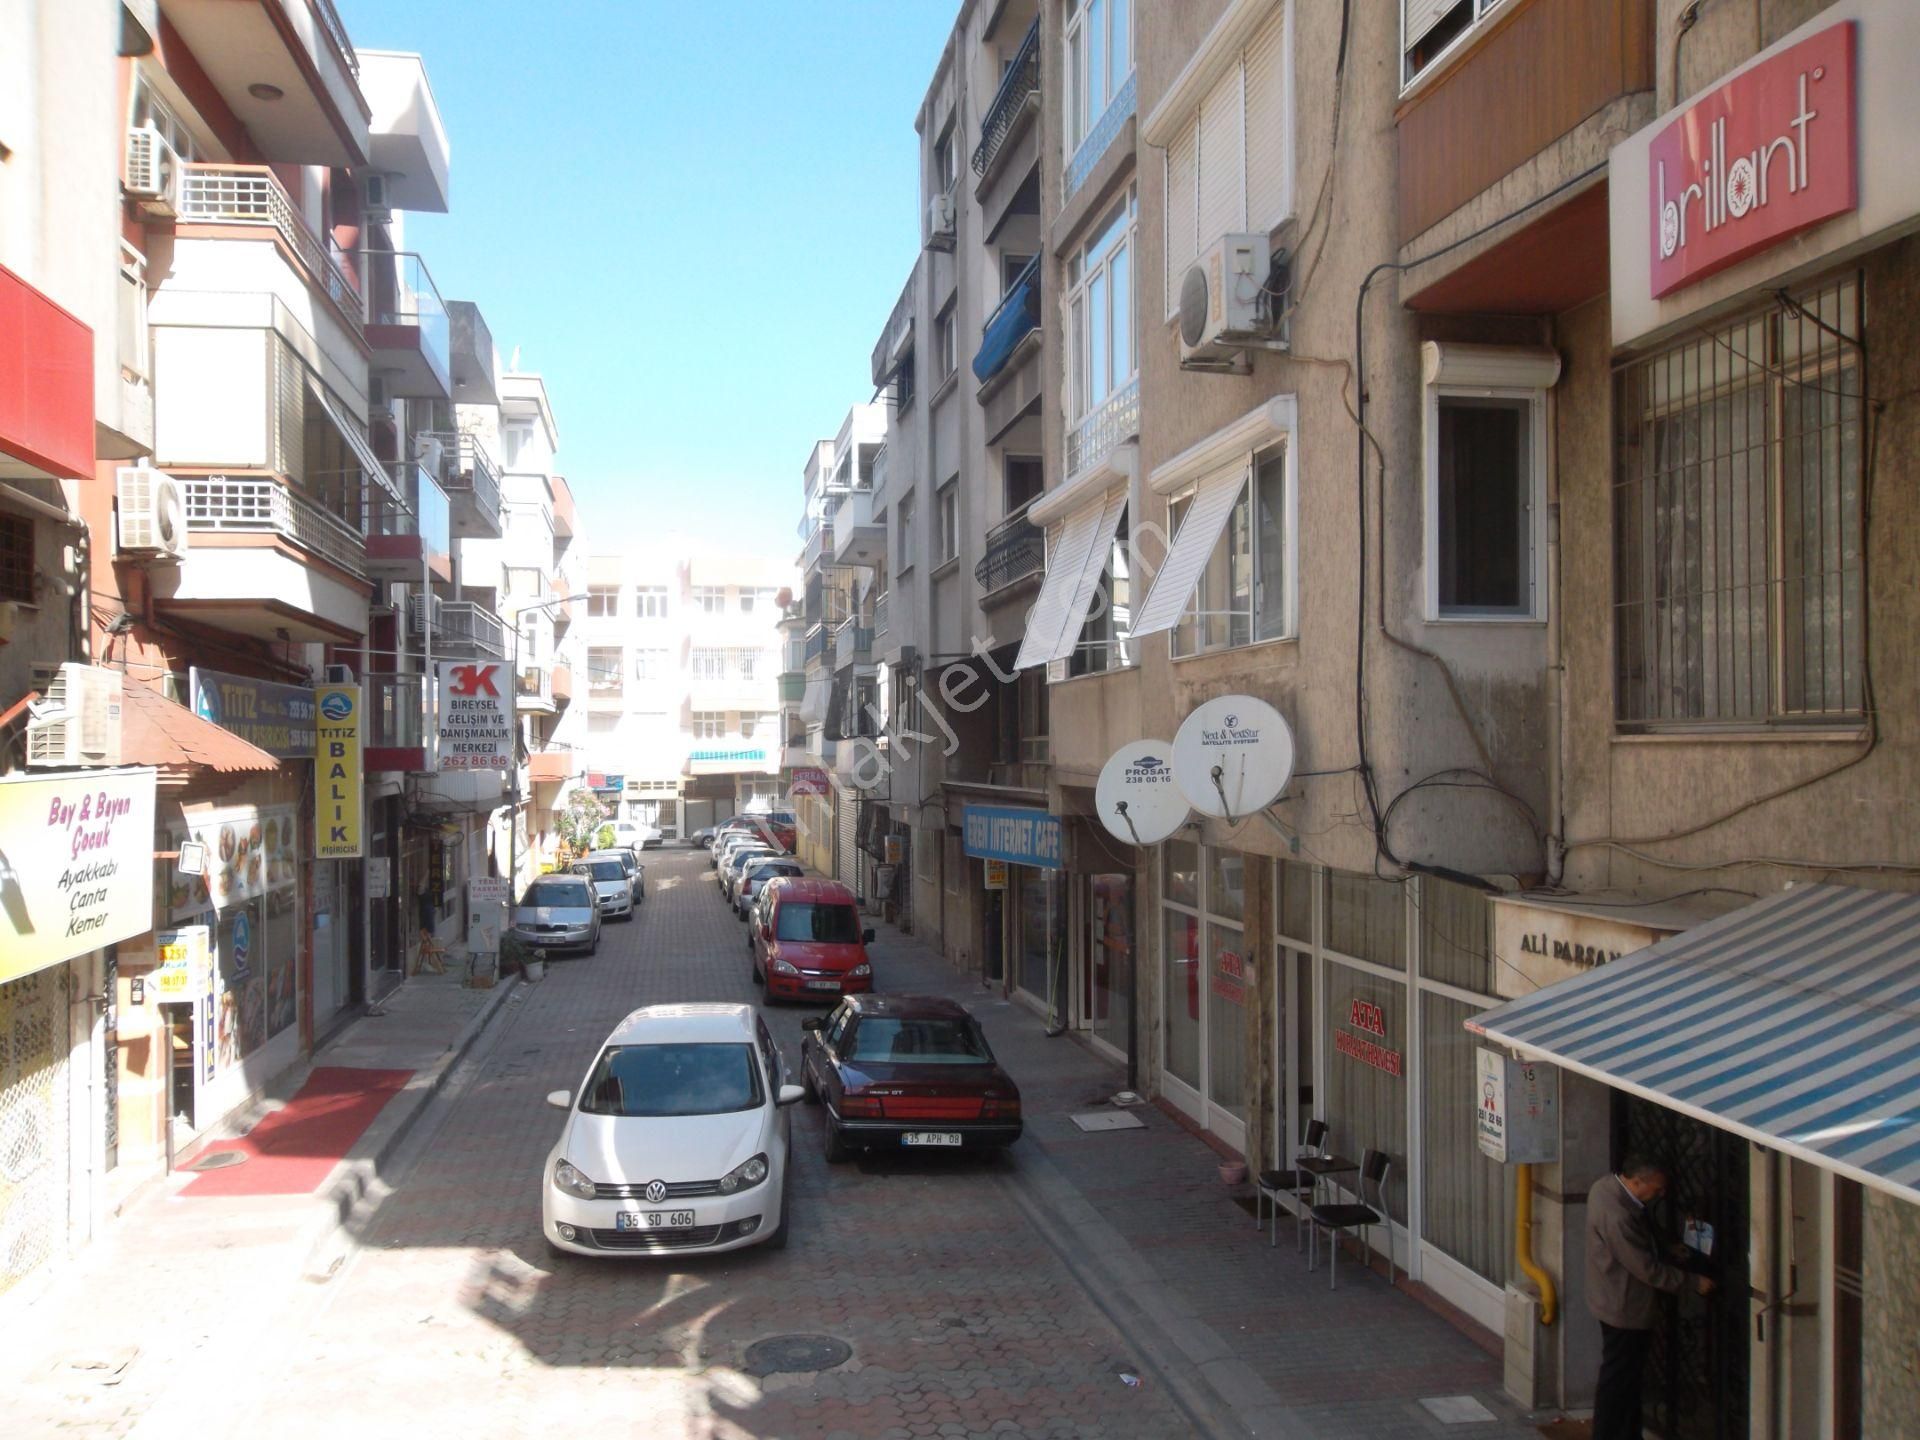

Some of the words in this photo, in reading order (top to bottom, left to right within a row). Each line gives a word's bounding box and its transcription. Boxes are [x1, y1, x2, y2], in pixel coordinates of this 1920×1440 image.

[1659, 71, 1818, 260] brillant
[449, 665, 501, 697] 3K
[492, 714, 504, 724] VE
[440, 728, 509, 741] DANIŞMANLIK
[1202, 729, 1218, 740] Next
[453, 741, 497, 753] MERKEZİ
[443, 756, 467, 766] 262
[472, 755, 487, 766] 86
[491, 755, 507, 766] 66
[1125, 767, 1172, 776] PROSAT
[1125, 776, 1143, 784] 238
[1160, 775, 1171, 783] 16
[329, 742, 348, 842] BALIK
[48, 796, 76, 831] Bay
[79, 793, 91, 822] &
[95, 791, 131, 824] Bayan
[72, 821, 111, 861] Çocuk
[990, 816, 1033, 855] INTERNET
[1036, 820, 1059, 859] CAFE
[57, 858, 118, 892] Ayakkabı
[70, 888, 108, 916] Çanta
[65, 912, 109, 938] Kemer
[1349, 998, 1385, 1037] ATA
[1488, 1112, 1495, 1124] 22
[909, 1133, 920, 1143] 35
[926, 1133, 942, 1143] APH
[625, 1214, 639, 1227] 35
[648, 1213, 662, 1226] SD
[670, 1212, 692, 1225] 606
